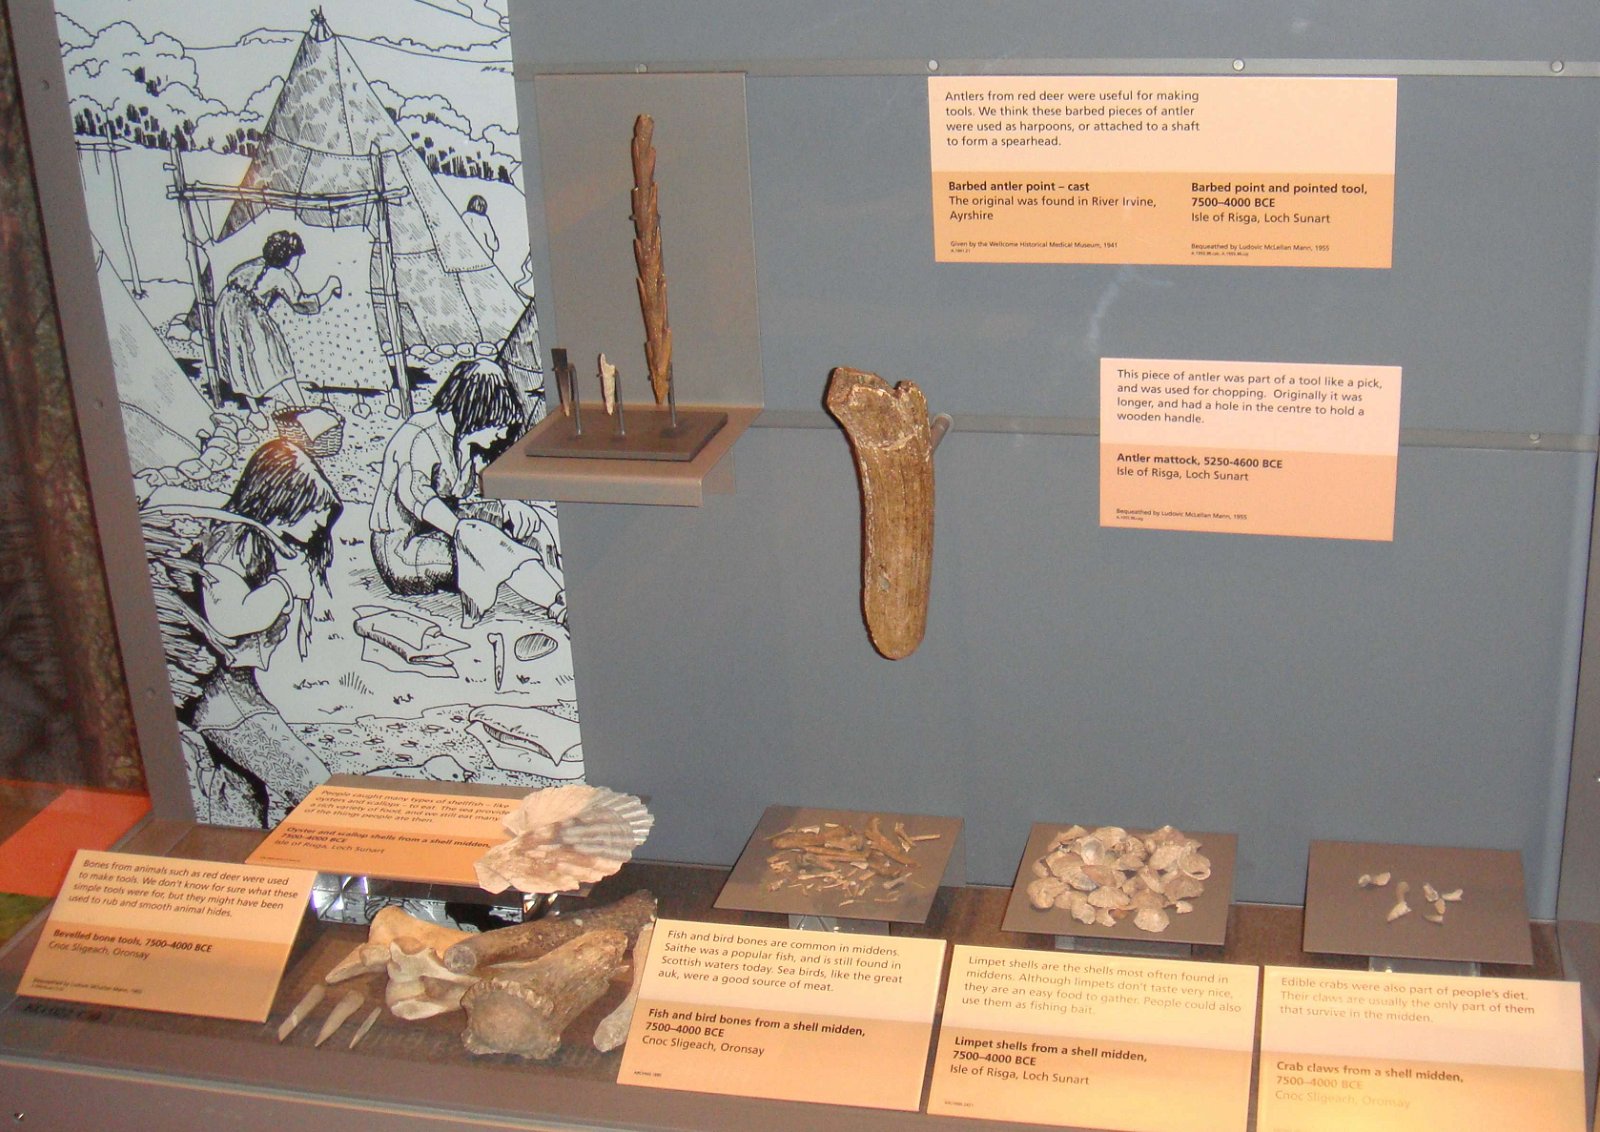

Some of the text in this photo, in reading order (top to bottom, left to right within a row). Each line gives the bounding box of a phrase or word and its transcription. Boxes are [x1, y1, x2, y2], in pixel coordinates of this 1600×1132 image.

[945, 90, 1199, 103] Antlers from red deer were useful for making
[1191, 181, 1367, 195] Barbed point and pointed tool,
[1254, 197, 1275, 208] BCE
[949, 209, 993, 222] Ayrshire
[1191, 211, 1330, 225] Isle of Risga, Loch Sunart
[1116, 383, 1362, 402] and was used for chopping. Originally it was
[1116, 411, 1204, 423] wooden handle.
[1116, 452, 1282, 469] Antler mattock, 5250-4600 BCE
[1116, 466, 1248, 481] Isle of Risga, Loch Sunart
[82, 859, 110, 869] Bones
[110, 861, 133, 871] from
[133, 864, 168, 874] animals
[168, 868, 189, 876] such
[202, 871, 219, 879] red
[219, 871, 241, 881] deer
[242, 875, 265, 883] were
[266, 877, 289, 885] used
[68, 894, 90, 903] used
[90, 895, 101, 904] to
[101, 897, 118, 906] rub
[119, 899, 138, 908] and
[138, 901, 172, 911] smooth
[173, 904, 206, 914] animal
[53, 928, 92, 940] Bevelled
[92, 932, 116, 943] bone
[193, 943, 212, 952] BCE
[667, 929, 687, 939] Fish
[689, 932, 711, 942] and
[712, 933, 734, 943] bird
[736, 935, 767, 946] bones
[790, 941, 836, 951] common
[839, 943, 849, 952] in
[852, 945, 899, 956] middens.
[968, 956, 1005, 967] Limpet
[1008, 959, 1038, 969] shells
[1040, 963, 1059, 971] are
[1062, 962, 1081, 973] the
[1083, 964, 1114, 975] shells
[1116, 969, 1143, 978] most
[1146, 969, 1177, 980] often
[1180, 971, 1215, 983] found
[1281, 976, 1528, 1000] Edible crabs were also part of people's diet.
[648, 1008, 669, 1019] Fish
[671, 1011, 693, 1021] and
[694, 1011, 717, 1023] bird
[719, 1014, 751, 1026] bones
[754, 1016, 780, 1028] from
[792, 1020, 818, 1032] shell
[821, 1023, 865, 1037] midden,
[703, 1026, 724, 1037] BCE
[641, 1034, 764, 1057] Cnoc Sligeach, Oronsay
[954, 1036, 993, 1049] Limpet
[995, 1039, 1027, 1051] shells
[1031, 1042, 1058, 1054] from
[1071, 1045, 1098, 1057] shell
[1100, 1049, 1147, 1062] midden,
[1014, 1055, 1036, 1066] BCE
[950, 1064, 1089, 1085] Isle of Risga, Loch Sunart
[1276, 1060, 1303, 1071] Crab
[1306, 1062, 1339, 1073] claws
[1343, 1064, 1371, 1076] from
[1384, 1067, 1412, 1078] shell
[1415, 1070, 1463, 1083] midden,
